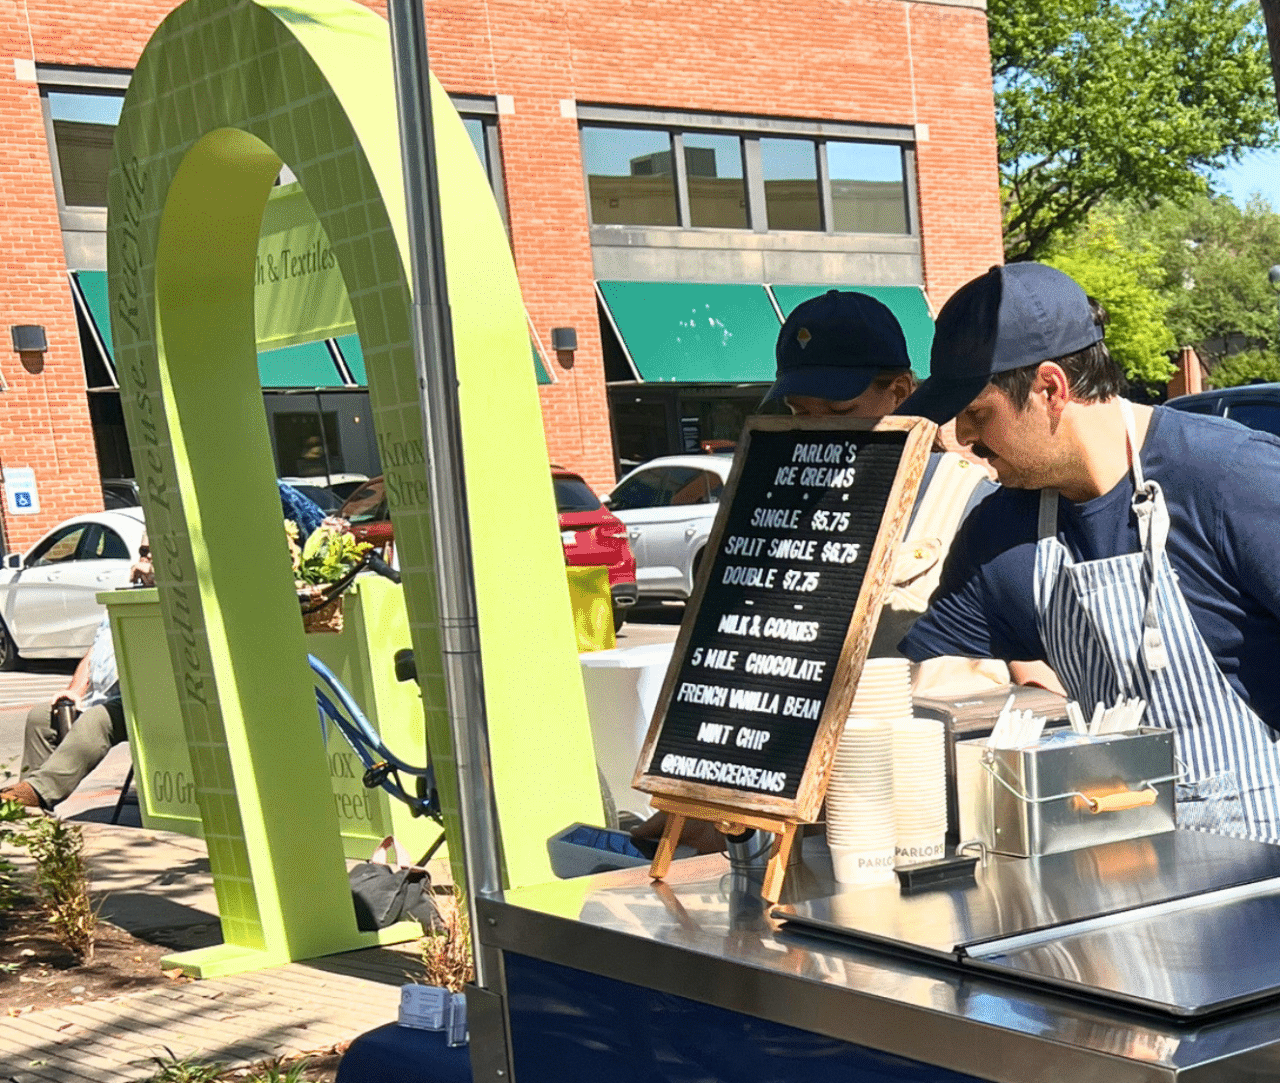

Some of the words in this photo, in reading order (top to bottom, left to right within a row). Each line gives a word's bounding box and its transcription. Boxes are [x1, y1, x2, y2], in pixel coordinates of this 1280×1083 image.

[267, 253, 279, 283] &
[281, 240, 335, 279] Textiles
[792, 441, 857, 464] PARLOR'S
[386, 471, 429, 506] Stre
[774, 466, 798, 486] ICE
[800, 467, 856, 488] CREAMS
[750, 508, 802, 530] SINGLE
[811, 509, 851, 532] $5.75
[724, 536, 767, 557] SPLIT
[767, 538, 818, 561] SINGLE
[820, 541, 861, 564] $6.75
[722, 566, 778, 588] DOUBLE
[782, 569, 821, 592] $7.75
[717, 614, 751, 637] MILK
[751, 615, 762, 638] &
[763, 617, 820, 642] COOKIES
[691, 648, 702, 667] 5
[704, 649, 739, 671] MILE
[745, 652, 826, 682] CHOCOLATE
[677, 682, 729, 708] FRENCH
[729, 689, 779, 715] VANILLA
[783, 695, 822, 720] BEAN
[697, 722, 734, 744] MINT
[736, 727, 771, 750] CHIP
[660, 753, 787, 793] @PARLORSICECREAMS
